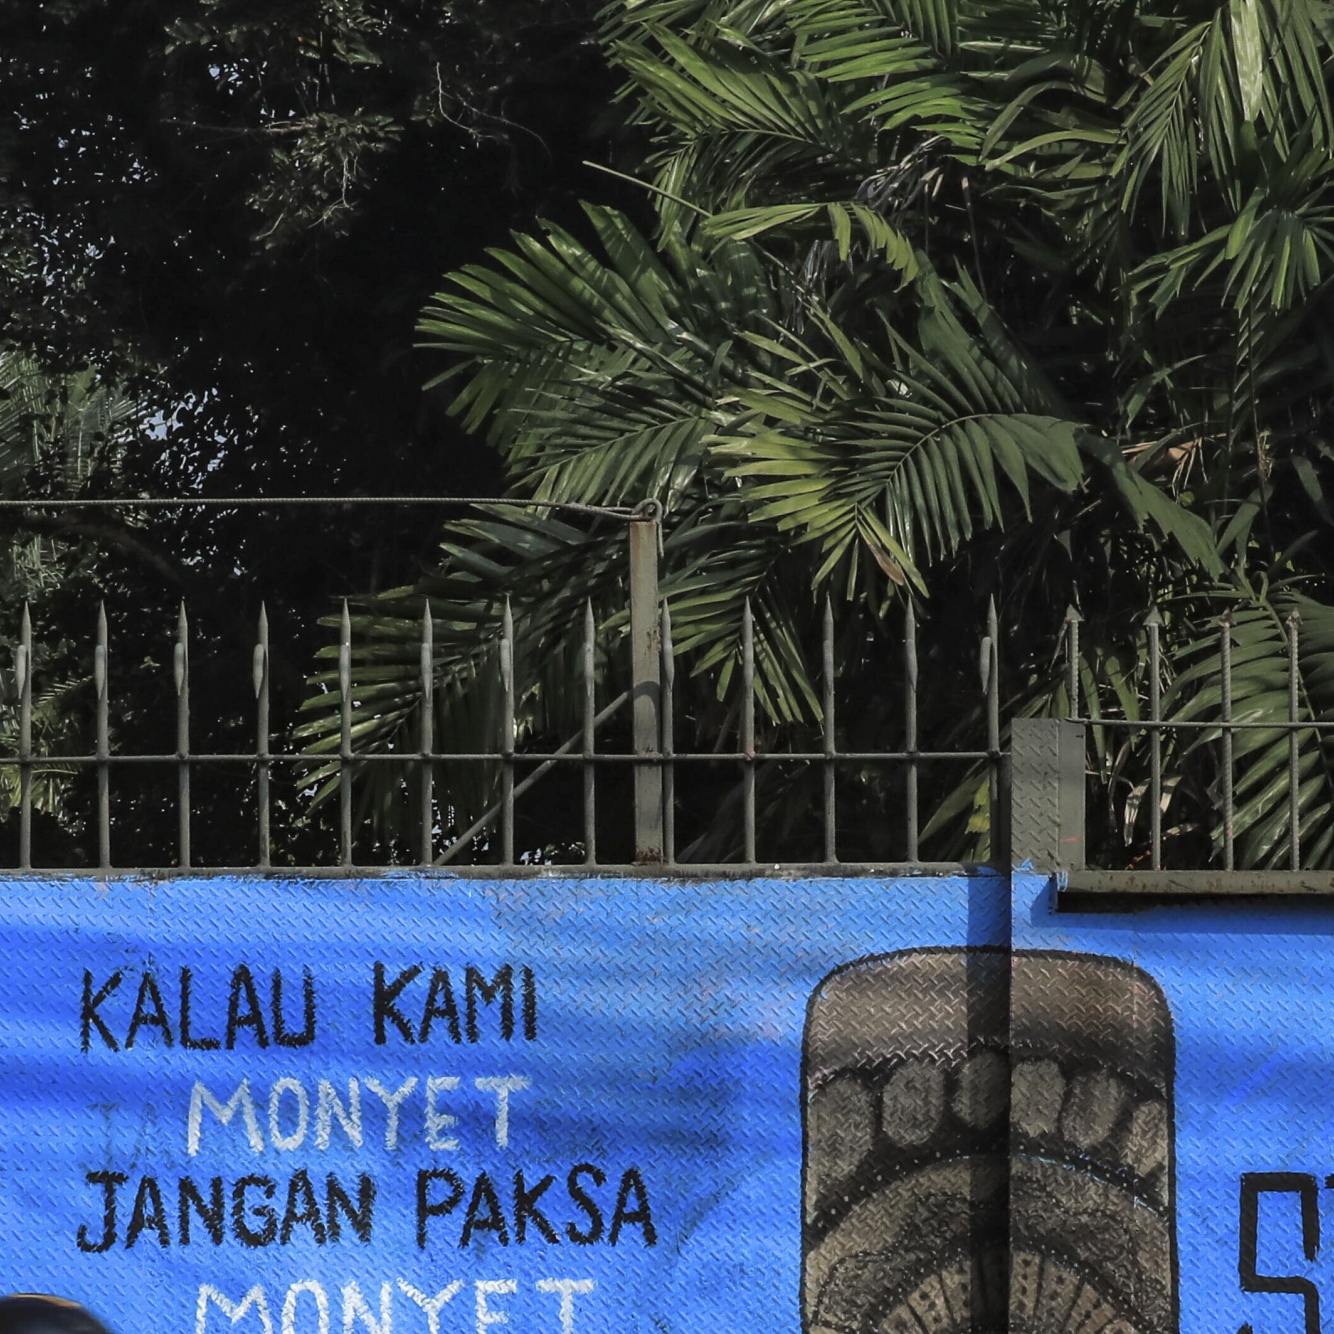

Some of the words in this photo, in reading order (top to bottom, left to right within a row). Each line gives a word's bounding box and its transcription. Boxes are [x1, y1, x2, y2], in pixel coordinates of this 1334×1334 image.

[79, 964, 317, 1053] KALAU
[372, 960, 539, 1046] KAMI
[186, 1073, 533, 1156] MONYET
[76, 1169, 376, 1253] JANGAN
[414, 1162, 659, 1249] PAKSA
